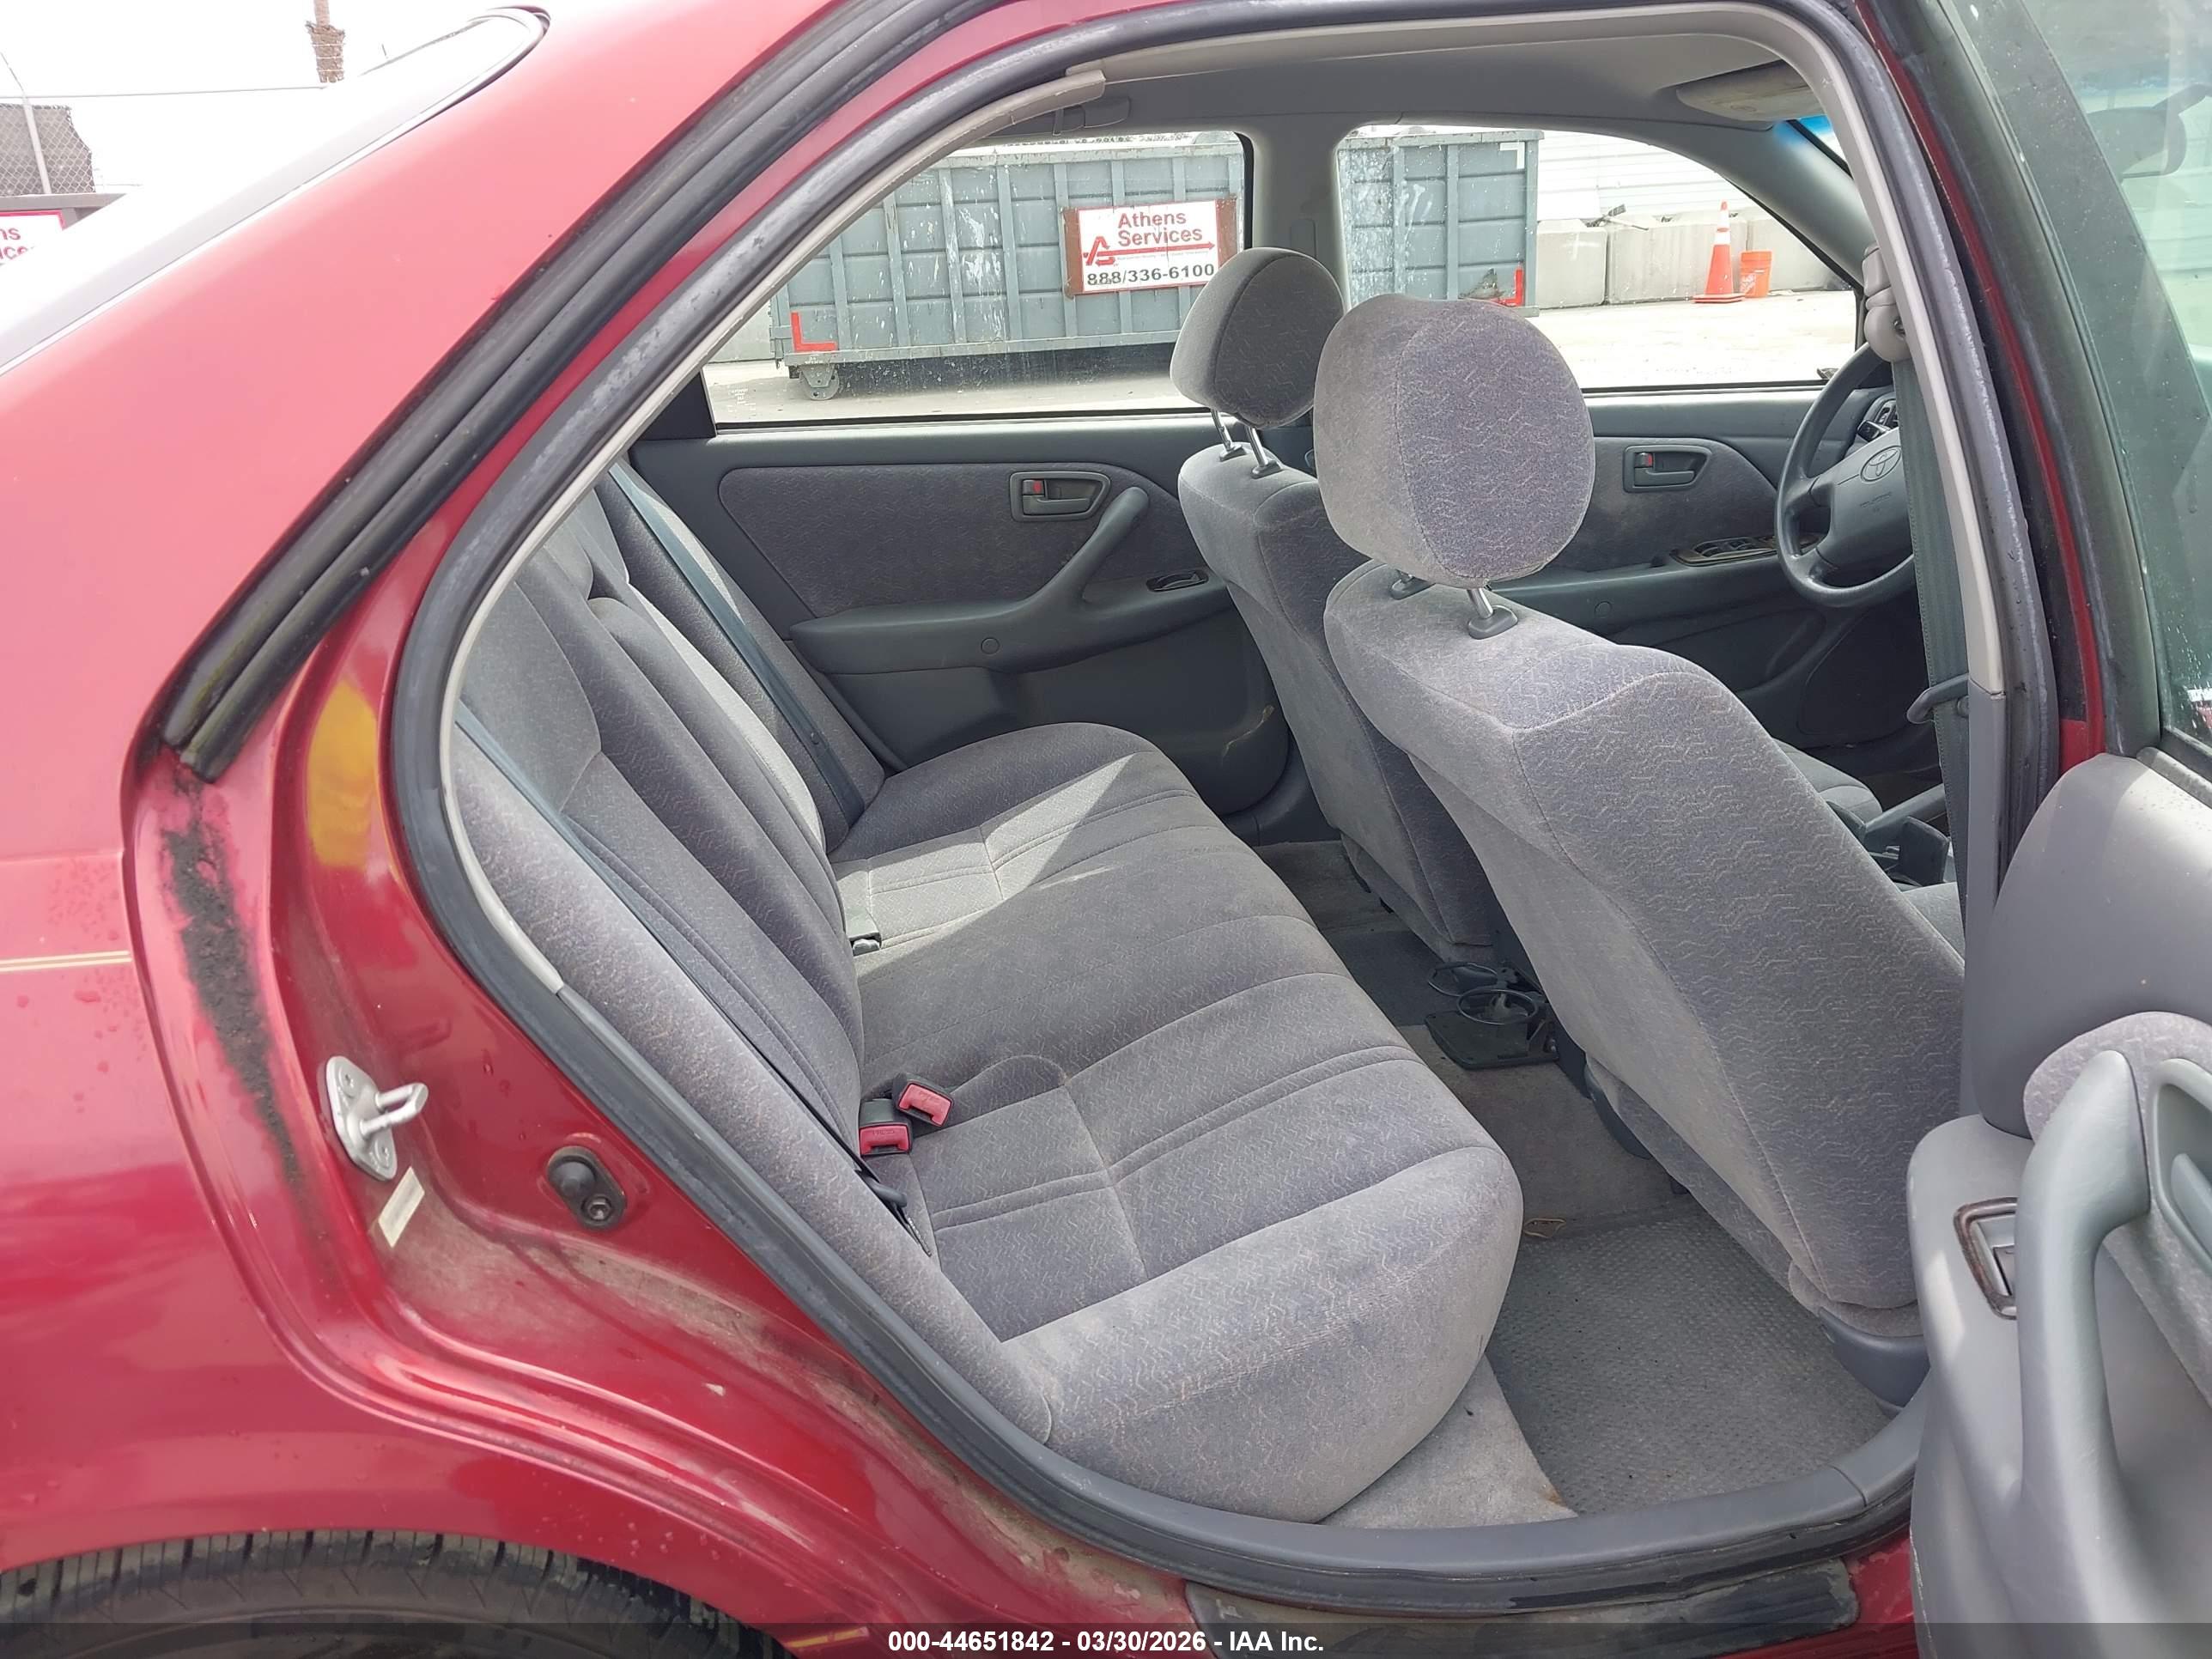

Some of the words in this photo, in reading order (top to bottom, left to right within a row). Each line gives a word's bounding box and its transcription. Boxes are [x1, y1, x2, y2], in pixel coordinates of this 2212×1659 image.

[1118, 212, 1187, 228] Athens
[1118, 228, 1202, 246] Services
[1087, 264, 1214, 286] 888/336-6100
